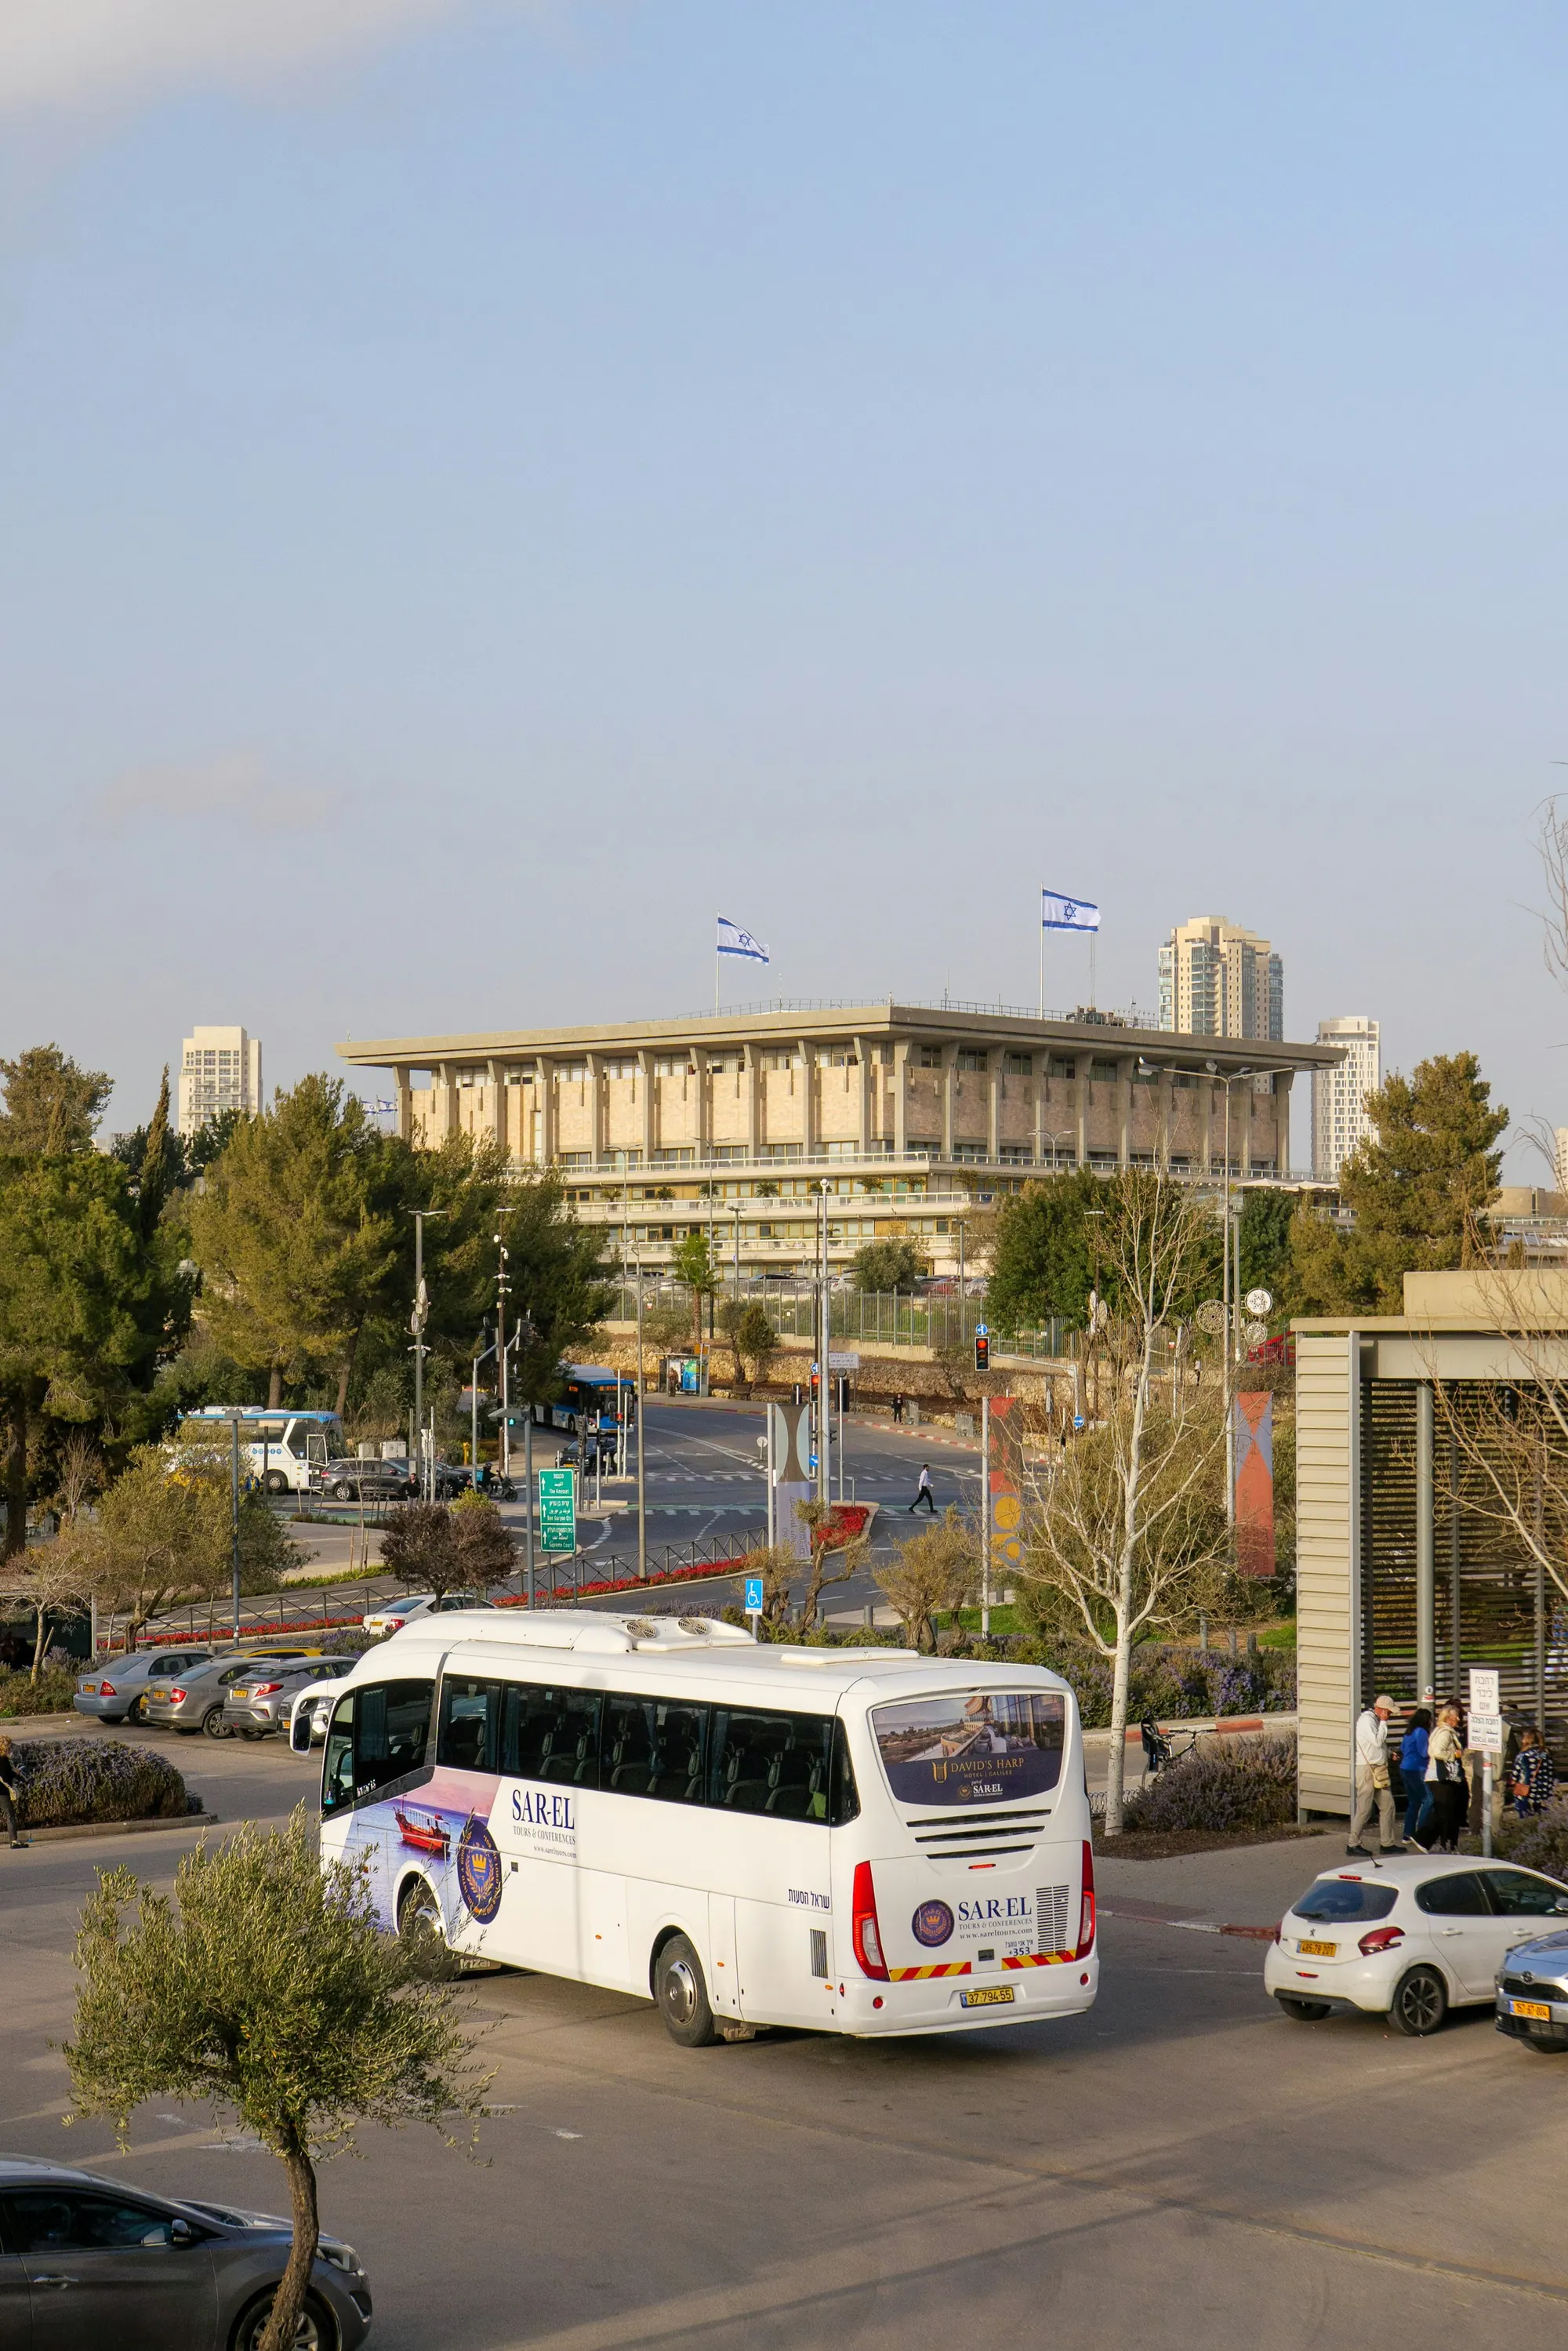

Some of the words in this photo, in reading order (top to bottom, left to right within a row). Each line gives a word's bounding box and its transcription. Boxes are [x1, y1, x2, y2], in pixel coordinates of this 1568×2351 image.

[950, 1760, 993, 1772] DAVID'S
[997, 1757, 1025, 1768] HARP
[512, 1790, 575, 1830] SAR-EL
[513, 1826, 532, 1837] TOURS
[532, 1830, 537, 1838] &
[537, 1830, 576, 1845] CONFERENCES
[533, 1846, 577, 1859] www.sareltours.com
[789, 1888, 809, 1905] הסעות
[958, 1897, 1032, 1921] SAR-EL
[989, 1918, 1033, 1928] CONFERENCES
[960, 1928, 1033, 1939] www.sareltours.com
